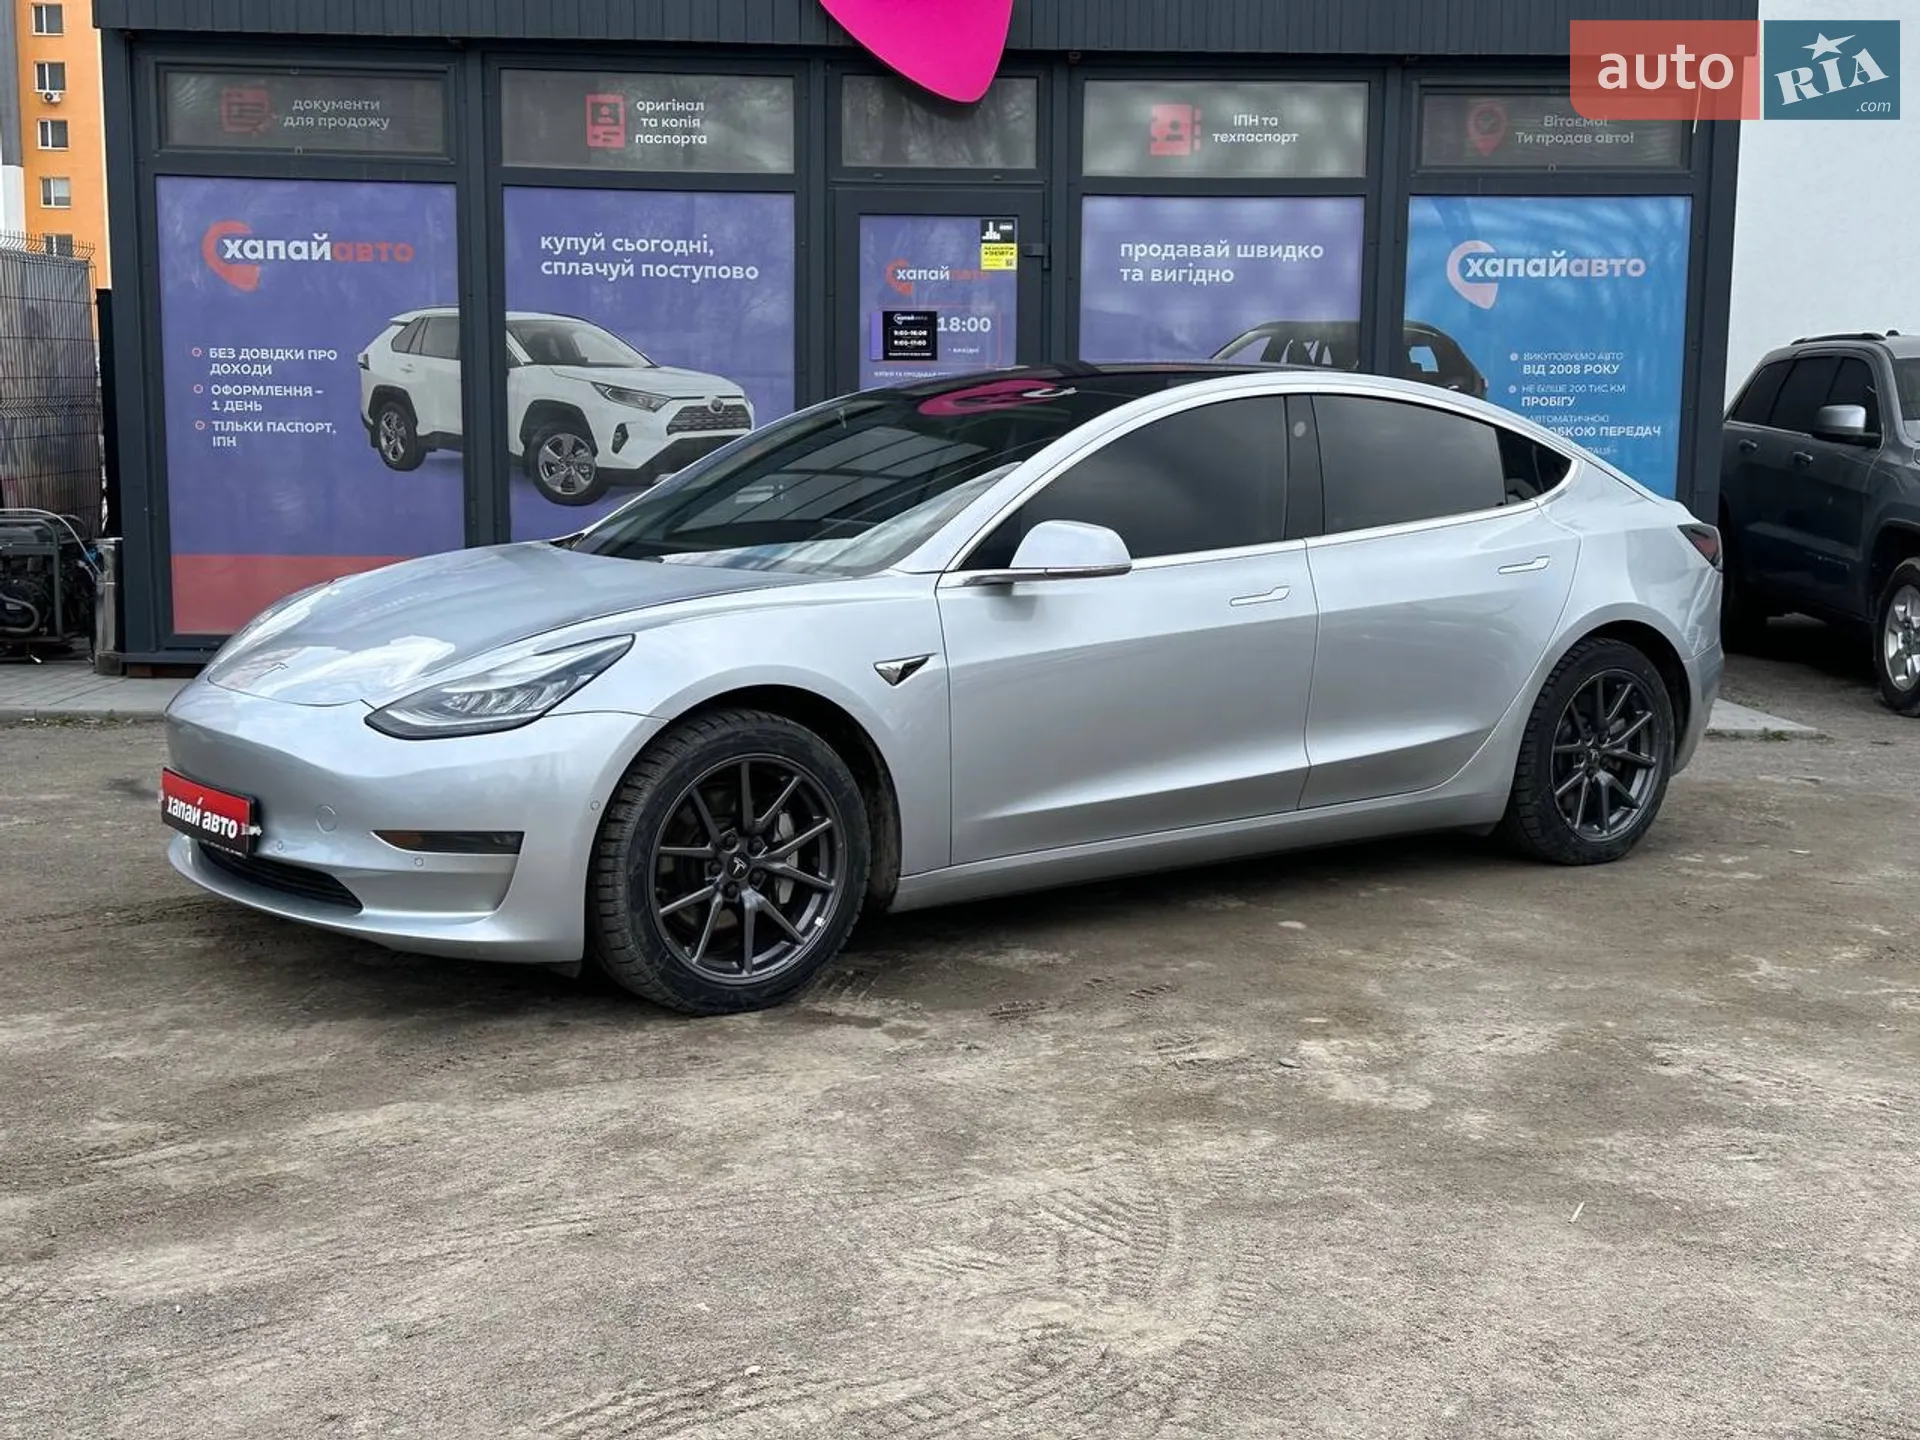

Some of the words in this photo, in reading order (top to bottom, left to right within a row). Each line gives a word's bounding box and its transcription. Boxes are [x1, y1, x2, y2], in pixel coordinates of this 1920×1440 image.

[291, 98, 380, 113] документи
[636, 98, 705, 114] оригінал
[283, 116, 314, 129] для
[641, 117, 658, 128] та
[661, 115, 701, 128] копія
[1233, 115, 1259, 127] ІПН
[1262, 116, 1279, 127] та
[635, 133, 708, 147] паспорта
[1212, 132, 1299, 146] техпаспорт
[1515, 131, 1533, 144] Ти
[1535, 132, 1593, 147] продав
[1595, 131, 1635, 144] авто!
[540, 231, 606, 256] купуй
[611, 233, 714, 257] сьогодні,
[1120, 239, 1231, 262] продавай
[1236, 243, 1325, 263] швидко
[540, 257, 635, 282] сплачуй
[641, 261, 760, 284] поступово
[1119, 266, 1145, 283] та
[1150, 261, 1235, 286] вигідно
[209, 348, 236, 359] БЕЗ
[238, 348, 305, 361] ДОВІДКИ
[308, 349, 338, 361] ПРО
[210, 363, 273, 377] ДОХОДИ
[1522, 364, 1546, 377] ВІД
[1549, 364, 1582, 375] 2008
[1584, 364, 1620, 375] РОКУ
[211, 384, 314, 397] ОФОРМЛЕННЯ
[211, 400, 221, 412] 1
[223, 400, 263, 413] ДЕНЬ
[1521, 396, 1576, 408] ПРОБІГУ
[211, 420, 263, 433] ТІЛЬКИ
[1599, 425, 1662, 438] ПЕРЕДАЧ
[212, 435, 237, 448] ІПН
[201, 811, 238, 839] авто
